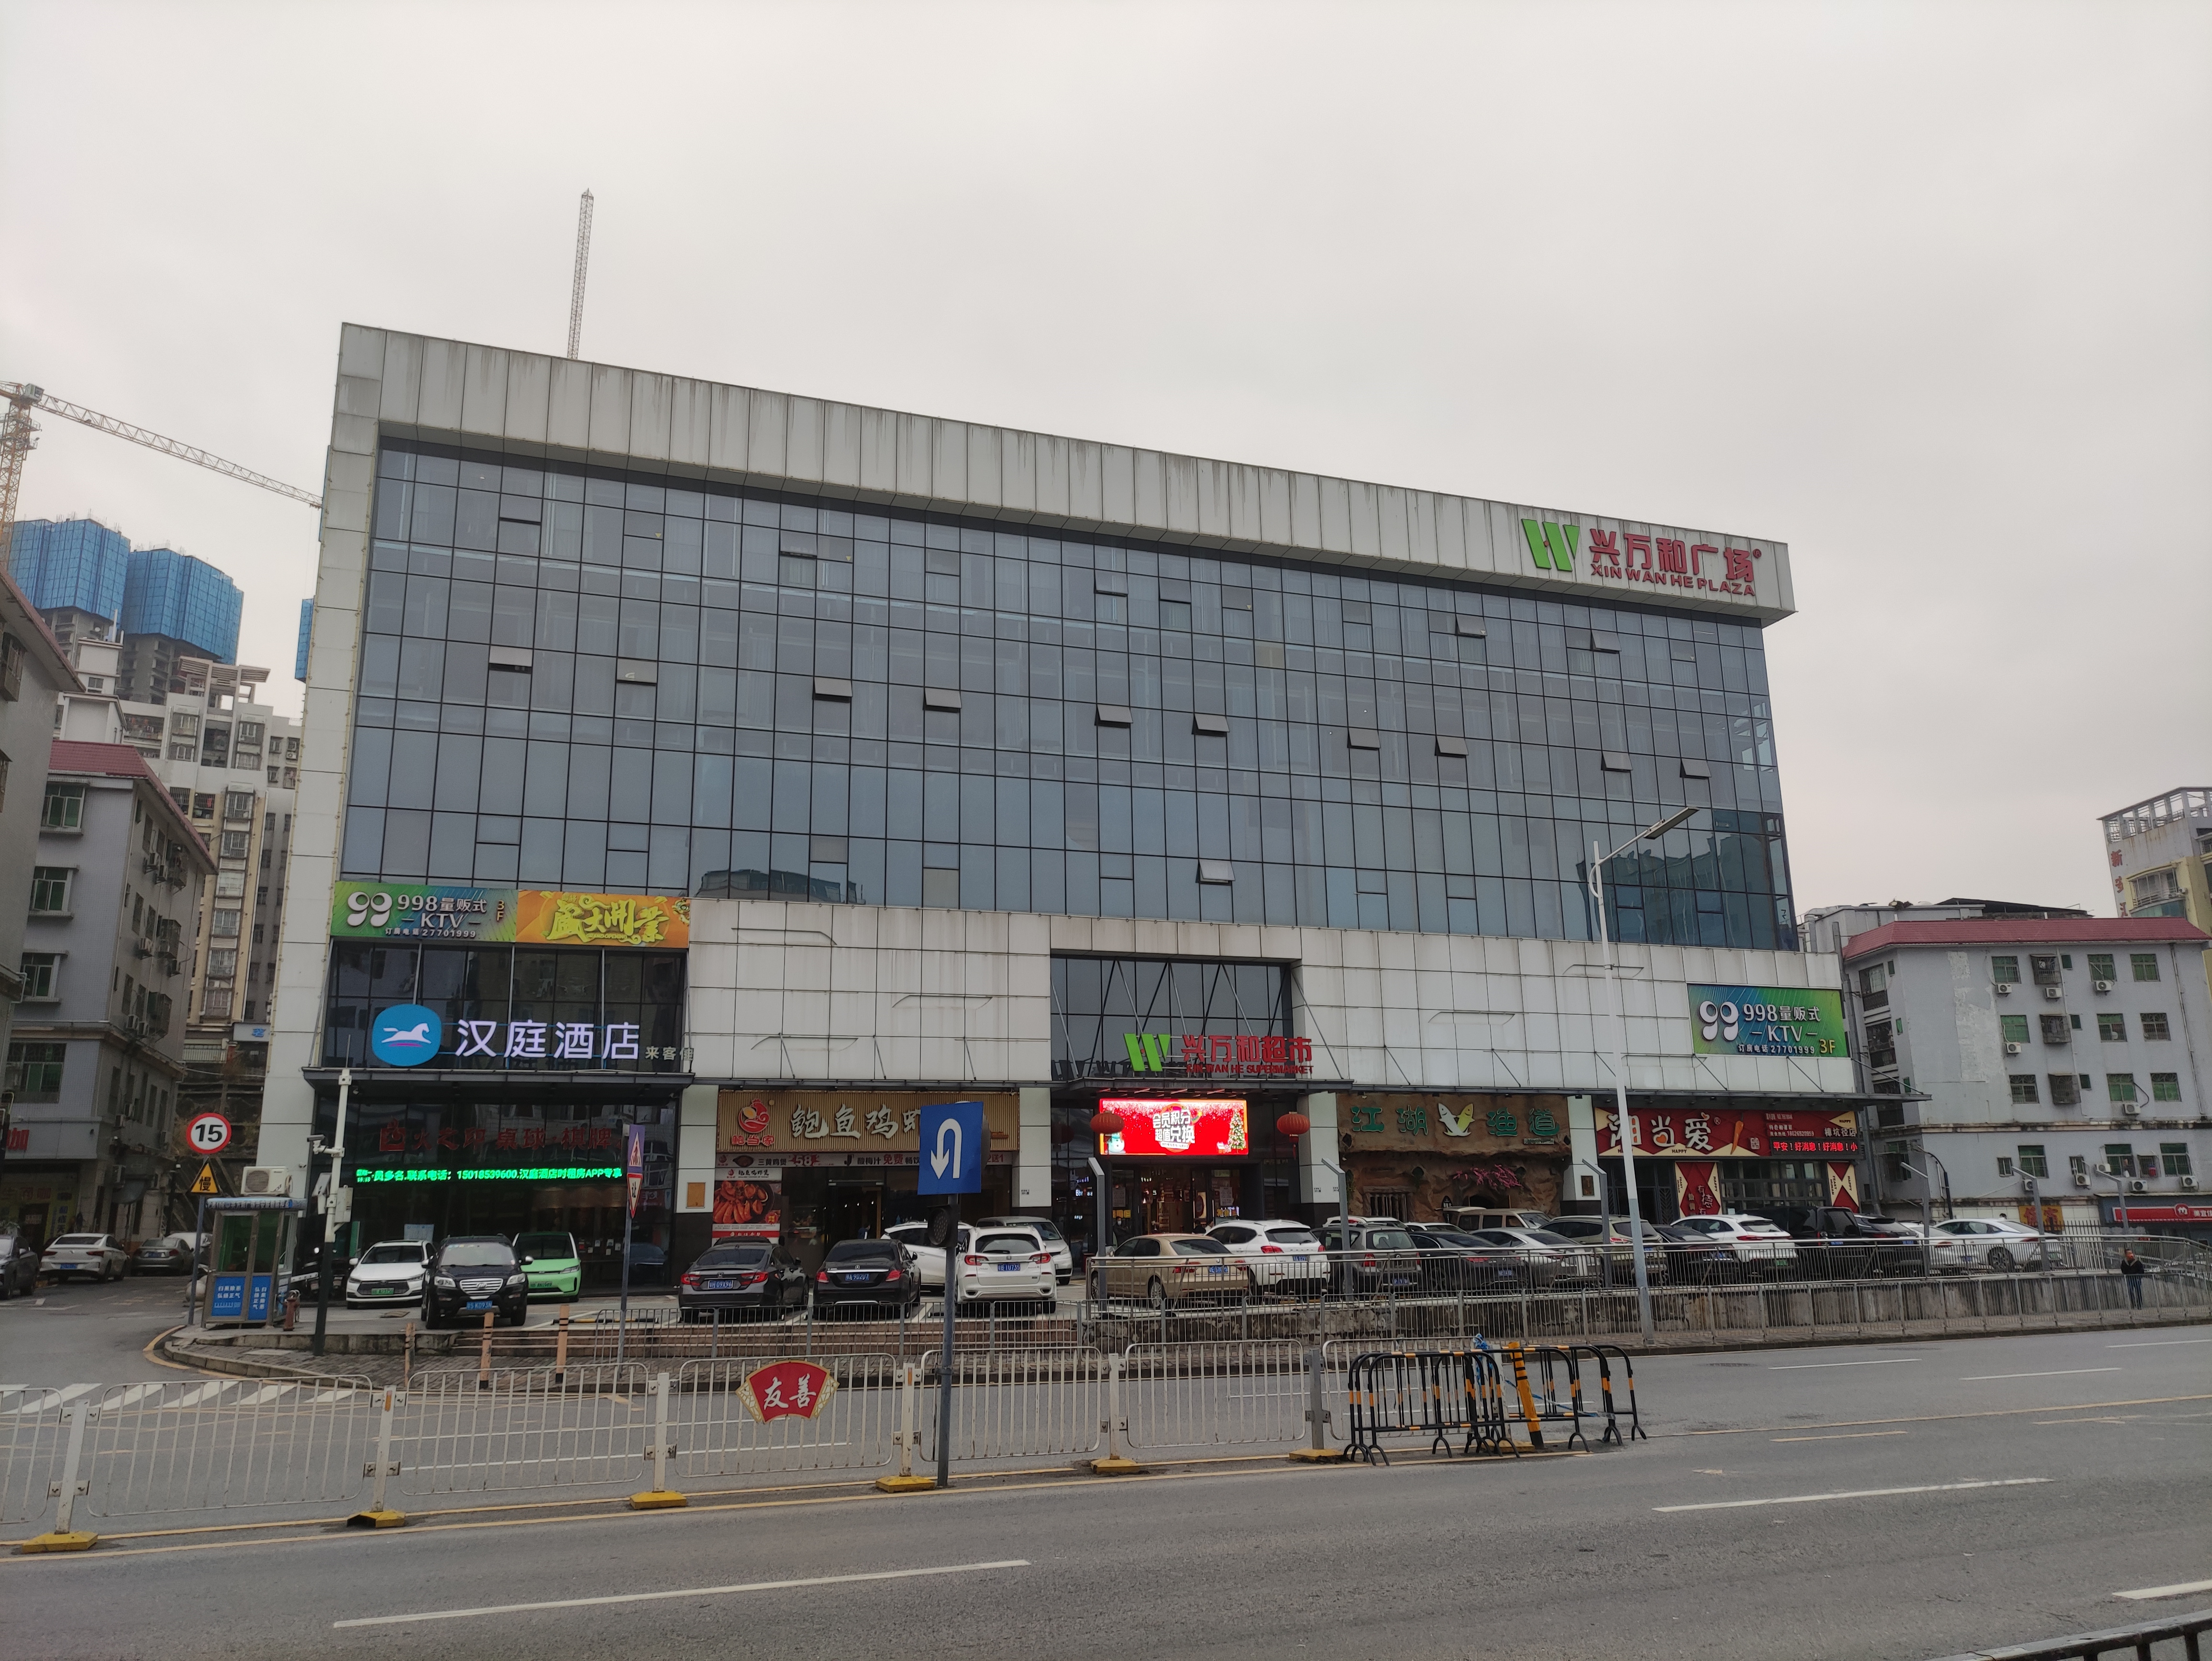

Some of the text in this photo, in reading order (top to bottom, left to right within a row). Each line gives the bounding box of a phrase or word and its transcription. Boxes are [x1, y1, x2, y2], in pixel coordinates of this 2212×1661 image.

[1589, 528, 1754, 582] 兴万和广场
[1591, 564, 1755, 596] XIN WAN HE PLAZA
[398, 894, 487, 913] 998量贩式
[421, 913, 464, 928] KTV
[1744, 1004, 1821, 1022] 998量贩式
[455, 1019, 640, 1059] 汉庭酒店
[1767, 1025, 1803, 1042] KTV
[1181, 1034, 1312, 1063] 兴万和超市
[1819, 1039, 1836, 1054] 3F
[1186, 1064, 1314, 1074] XIN WAN HE SUPERMARKET
[1152, 1109, 1191, 1129] 会员积分
[195, 1124, 223, 1142] 15
[1155, 1125, 1195, 1143] 超值兑换
[1824, 1127, 1857, 1138] 樟坑径店
[199, 1176, 211, 1191] 慢
[763, 1373, 816, 1410] 友善
